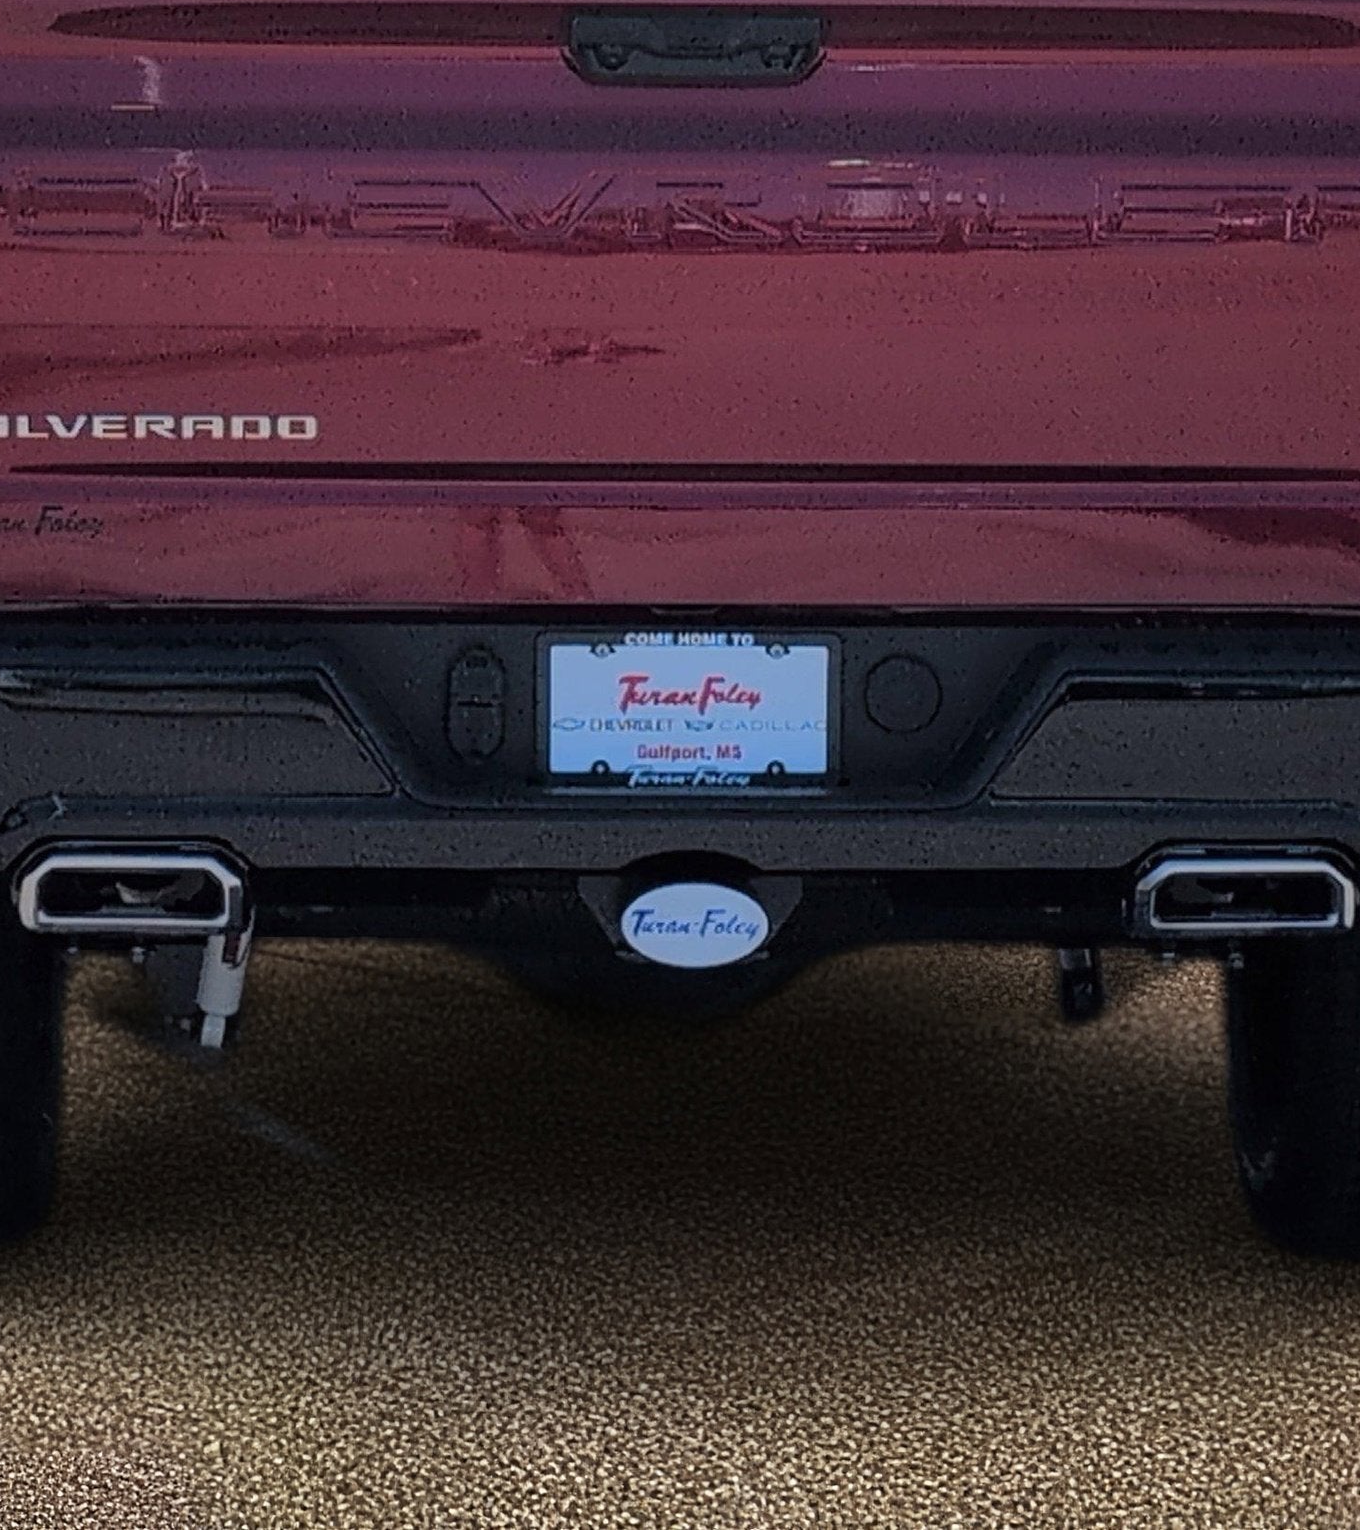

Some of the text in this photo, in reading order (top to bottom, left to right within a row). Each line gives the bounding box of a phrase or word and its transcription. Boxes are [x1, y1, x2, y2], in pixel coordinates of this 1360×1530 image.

[623, 631, 755, 646] COME HOME TO
[589, 718, 827, 732] CHEVROLET CADILLAC
[636, 744, 743, 762] Gulfport, MS
